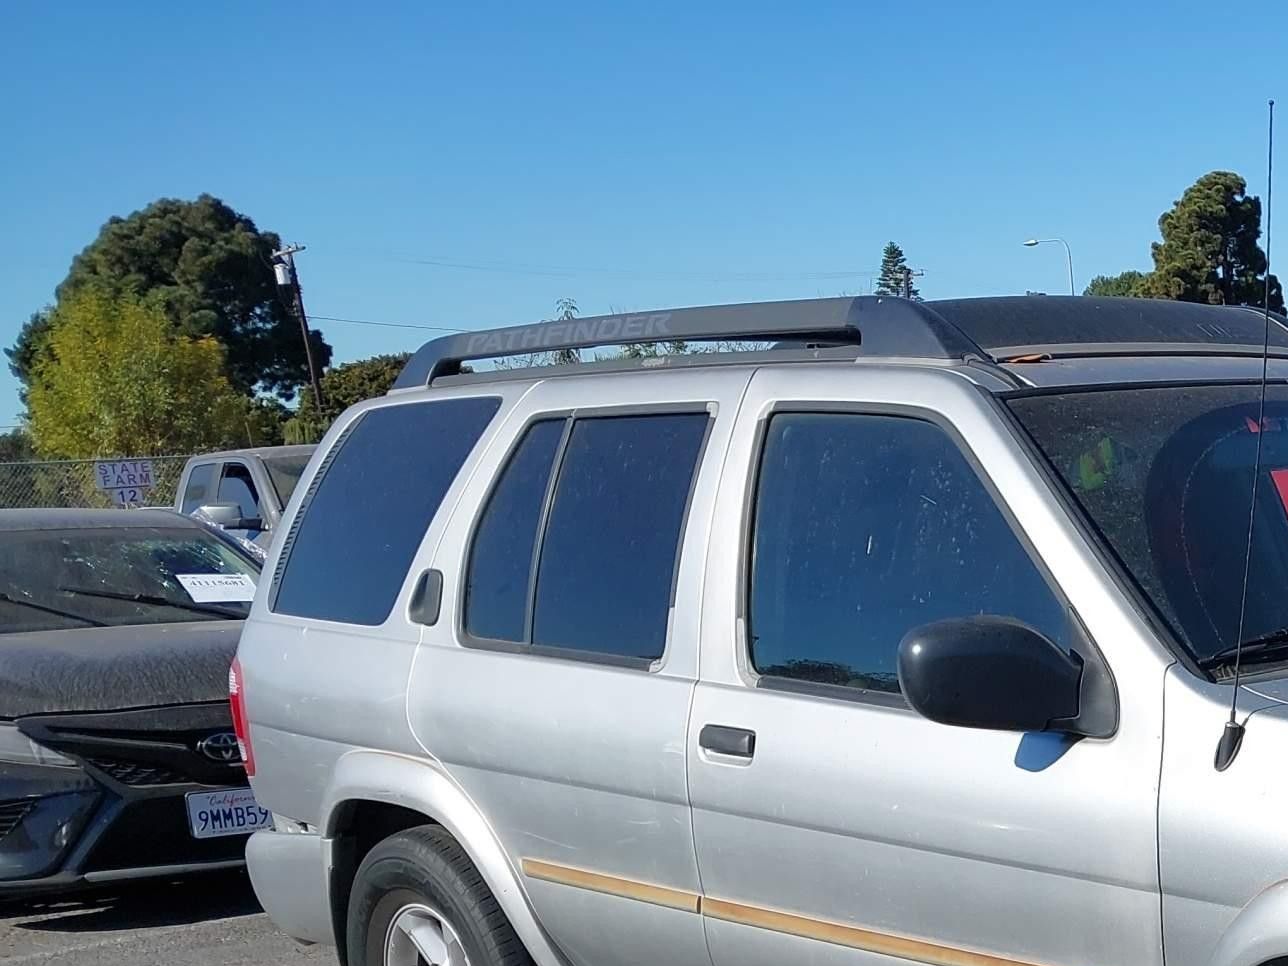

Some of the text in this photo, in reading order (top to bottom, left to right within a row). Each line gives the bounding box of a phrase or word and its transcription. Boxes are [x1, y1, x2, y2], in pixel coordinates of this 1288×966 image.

[466, 312, 673, 353] PATHFINDER
[98, 461, 151, 475] STATE
[102, 473, 151, 486] FARM
[118, 489, 138, 503] 12
